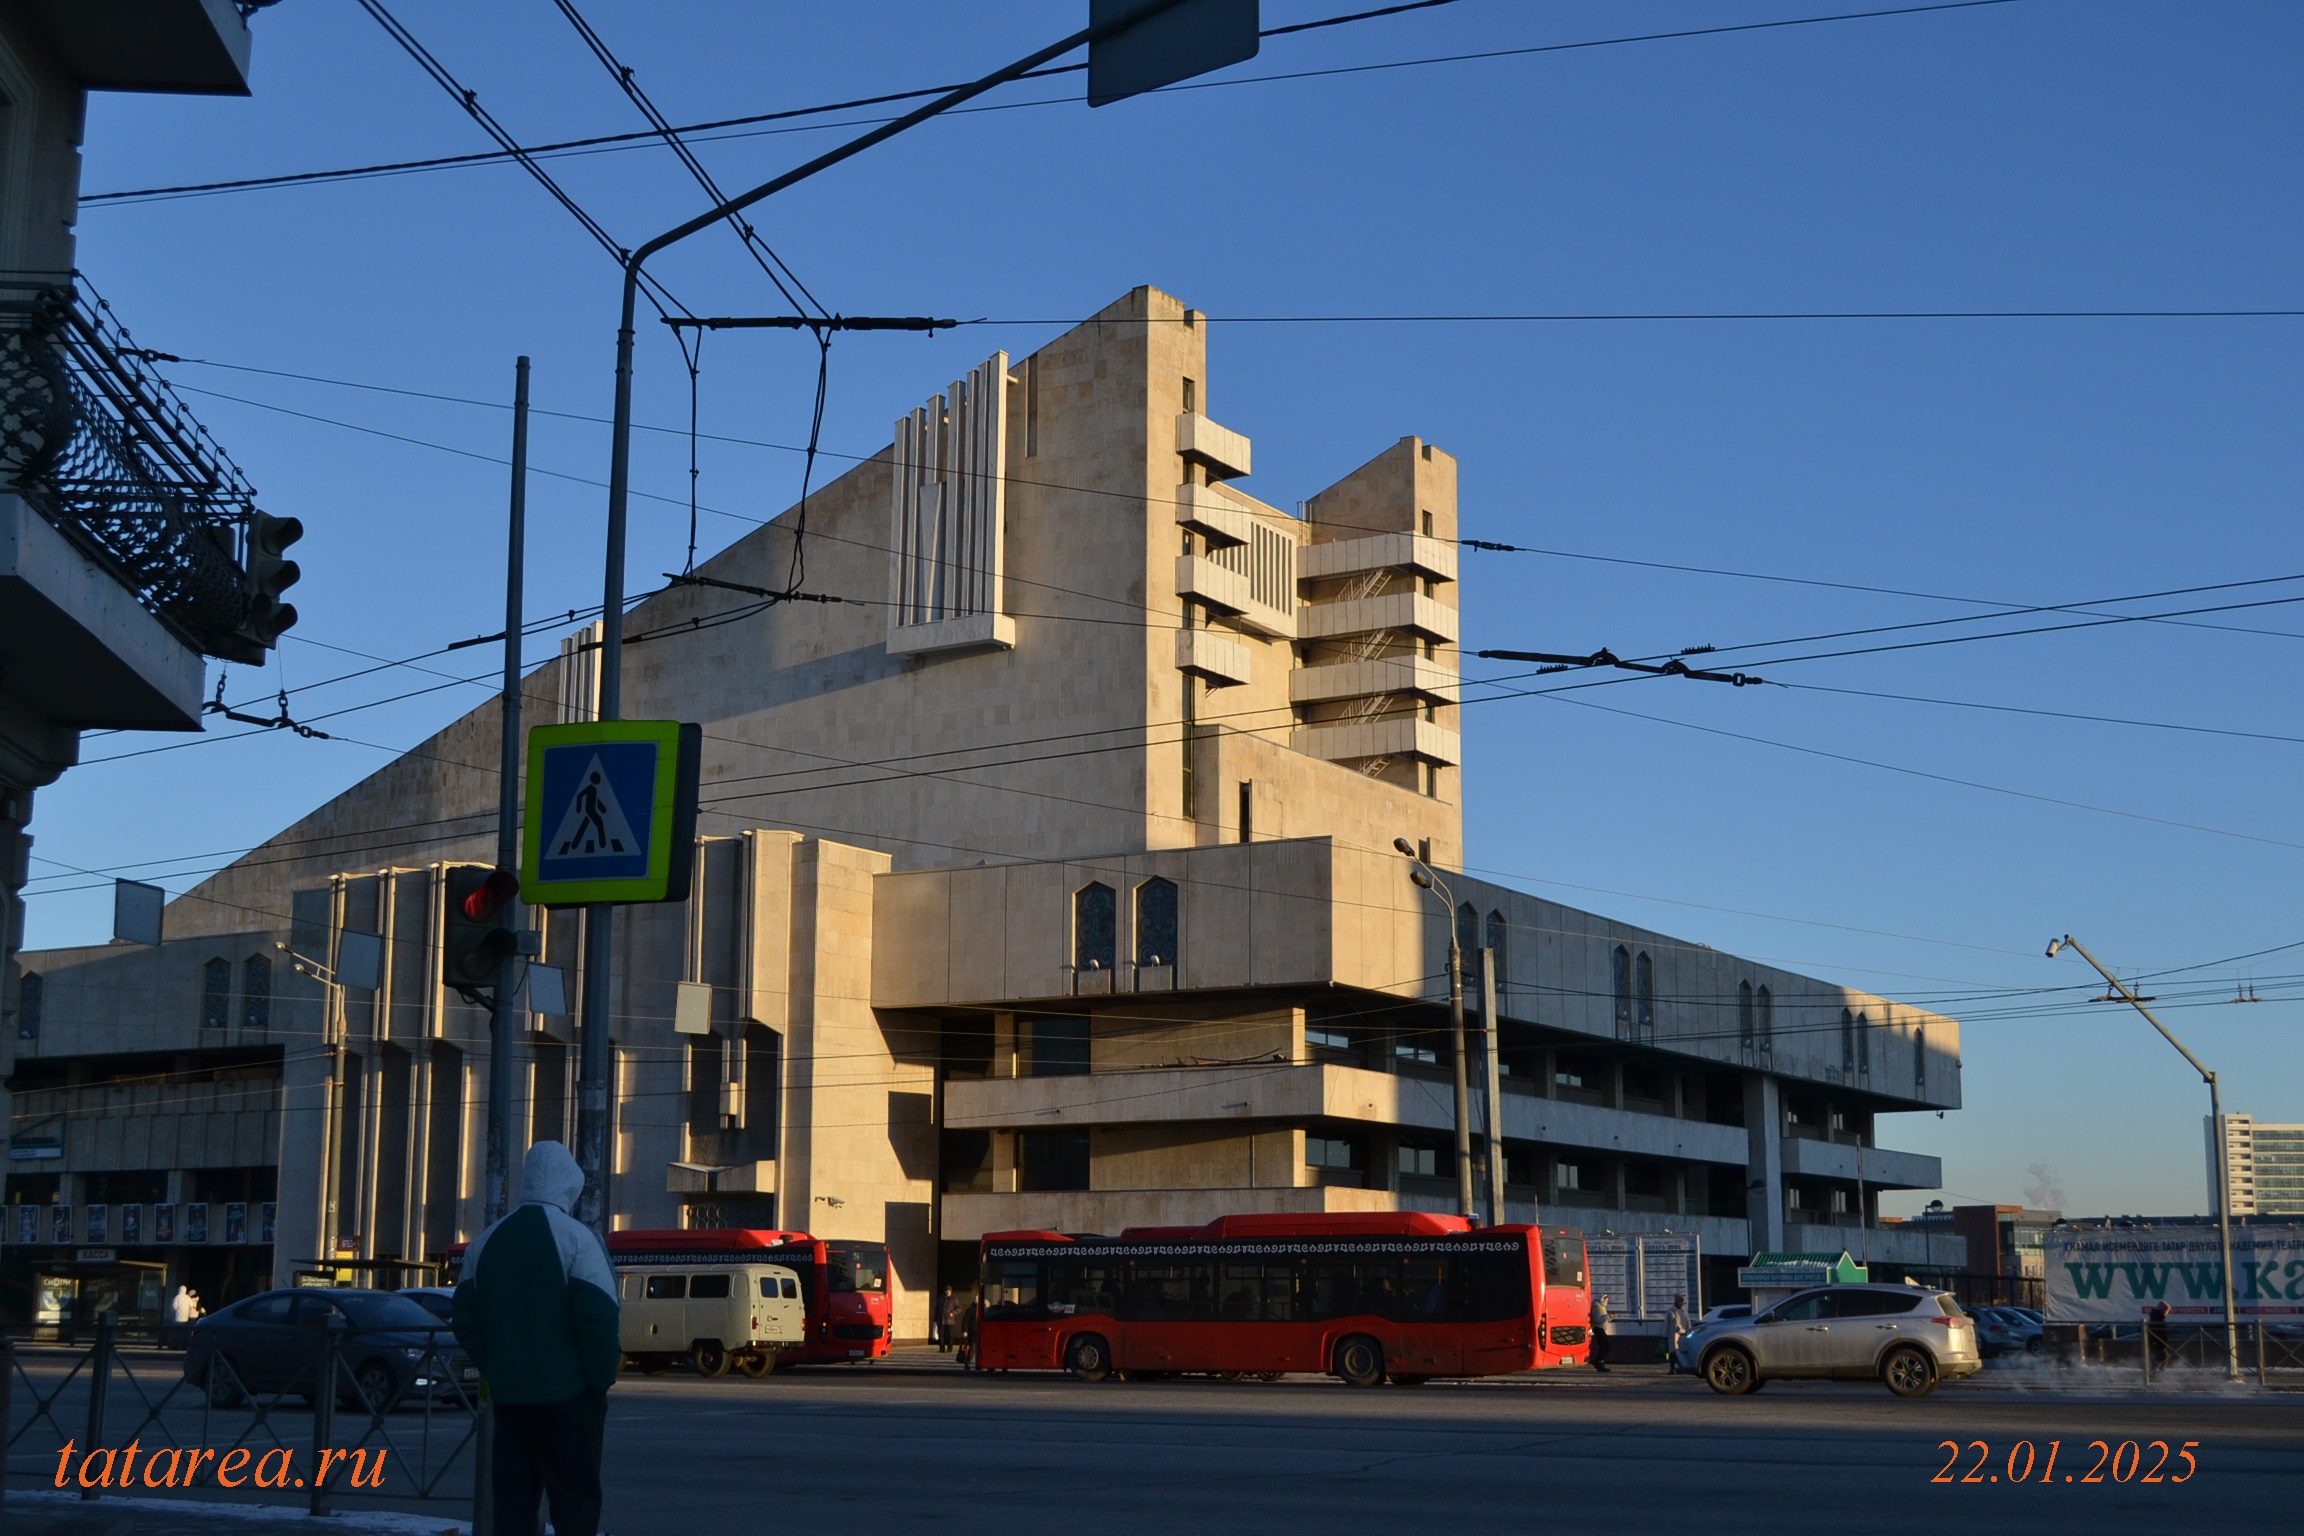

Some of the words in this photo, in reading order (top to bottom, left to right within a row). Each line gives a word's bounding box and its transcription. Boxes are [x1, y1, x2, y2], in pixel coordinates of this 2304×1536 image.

[2162, 1241, 2186, 1251] ТАТАР
[2230, 1241, 2272, 1252] КАДЕМИЯ
[83, 1250, 110, 1259] КАССА
[43, 1277, 71, 1287] СМОТРИ
